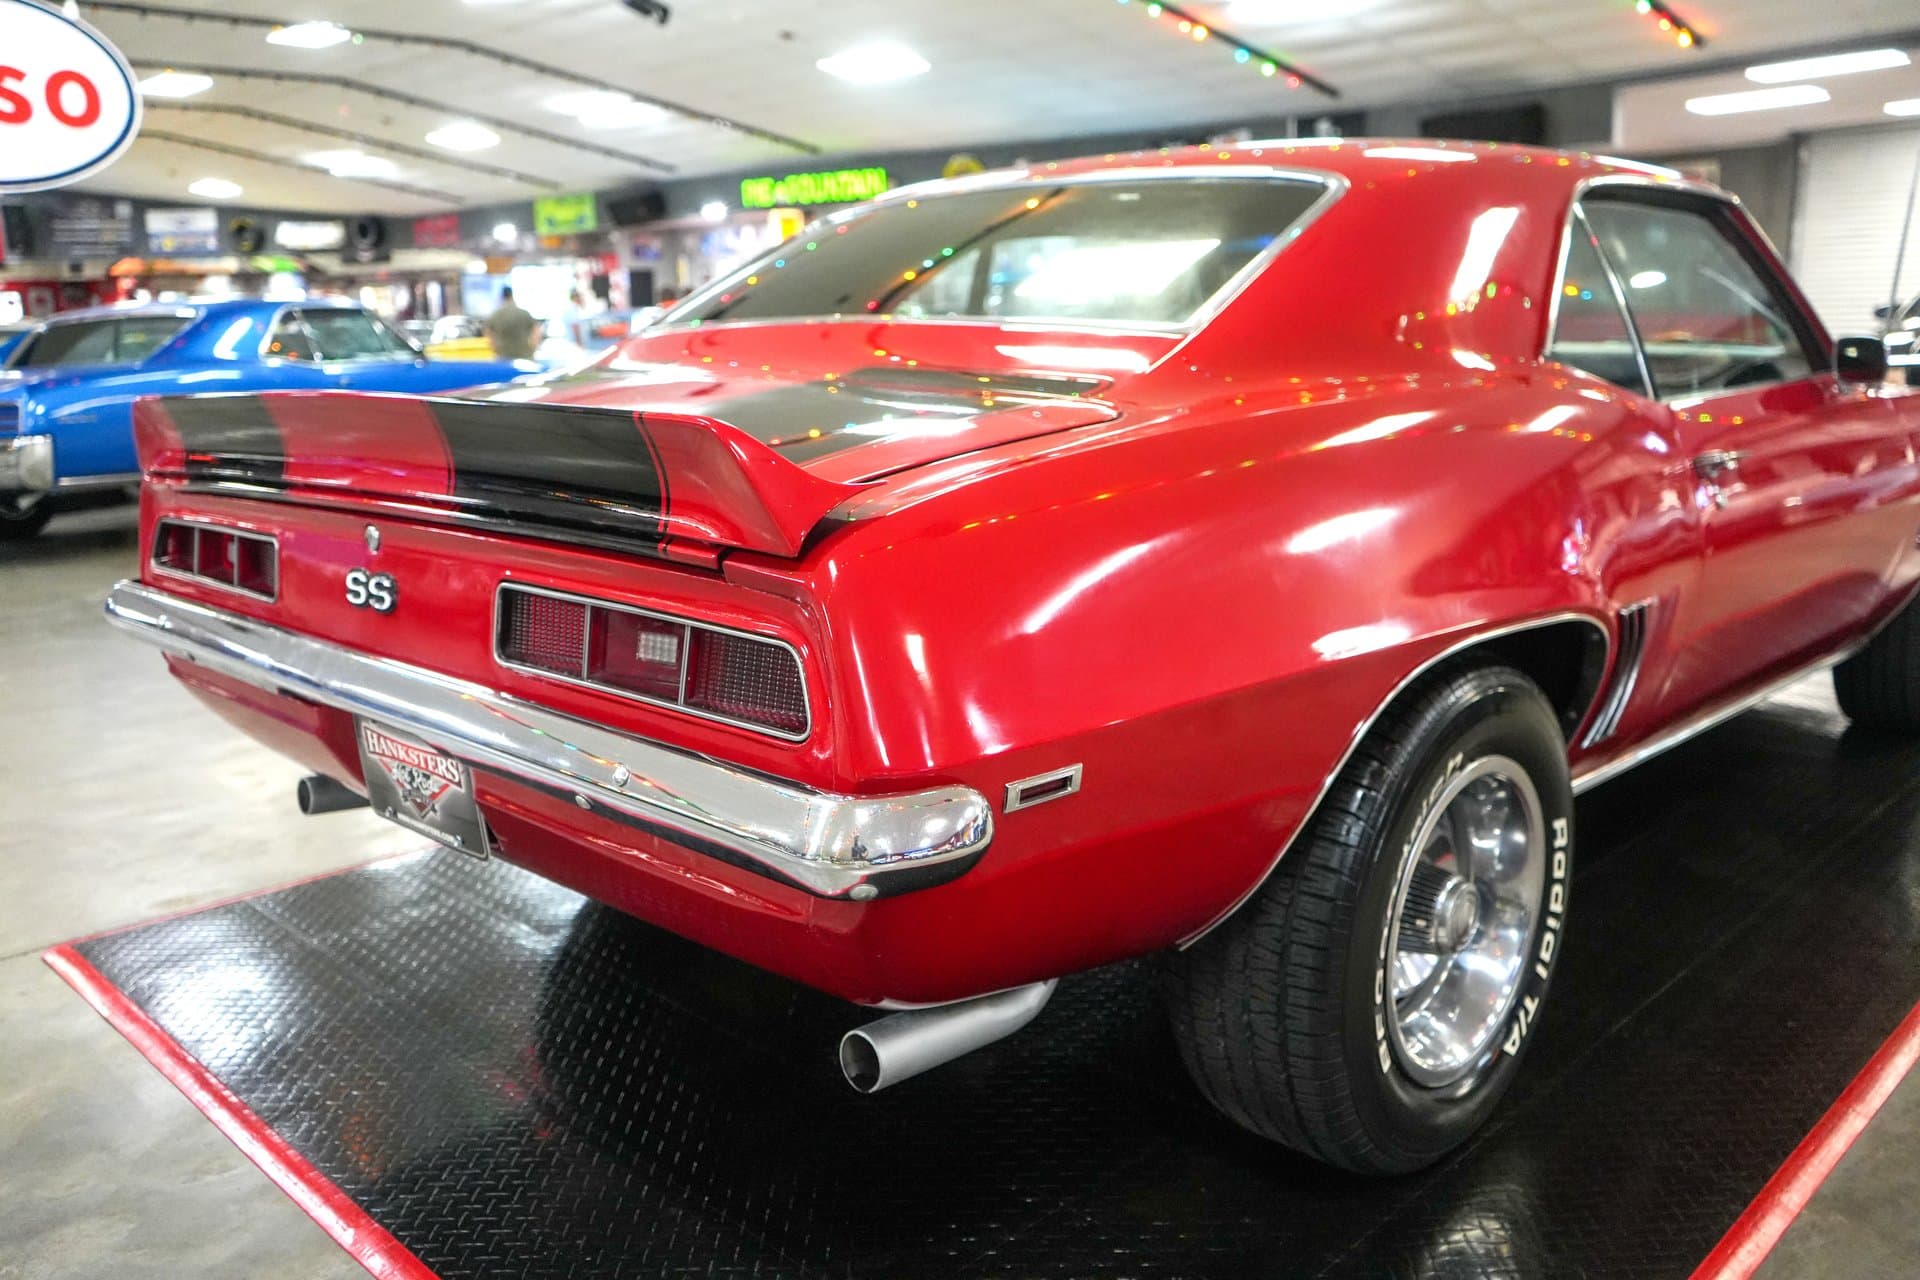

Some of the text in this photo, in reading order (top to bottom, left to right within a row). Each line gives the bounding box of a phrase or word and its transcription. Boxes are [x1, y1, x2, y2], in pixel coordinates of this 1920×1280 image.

[345, 568, 396, 613] SS
[365, 729, 460, 783] HANKSTERS
[1502, 817, 1569, 1057] Radial T/A
